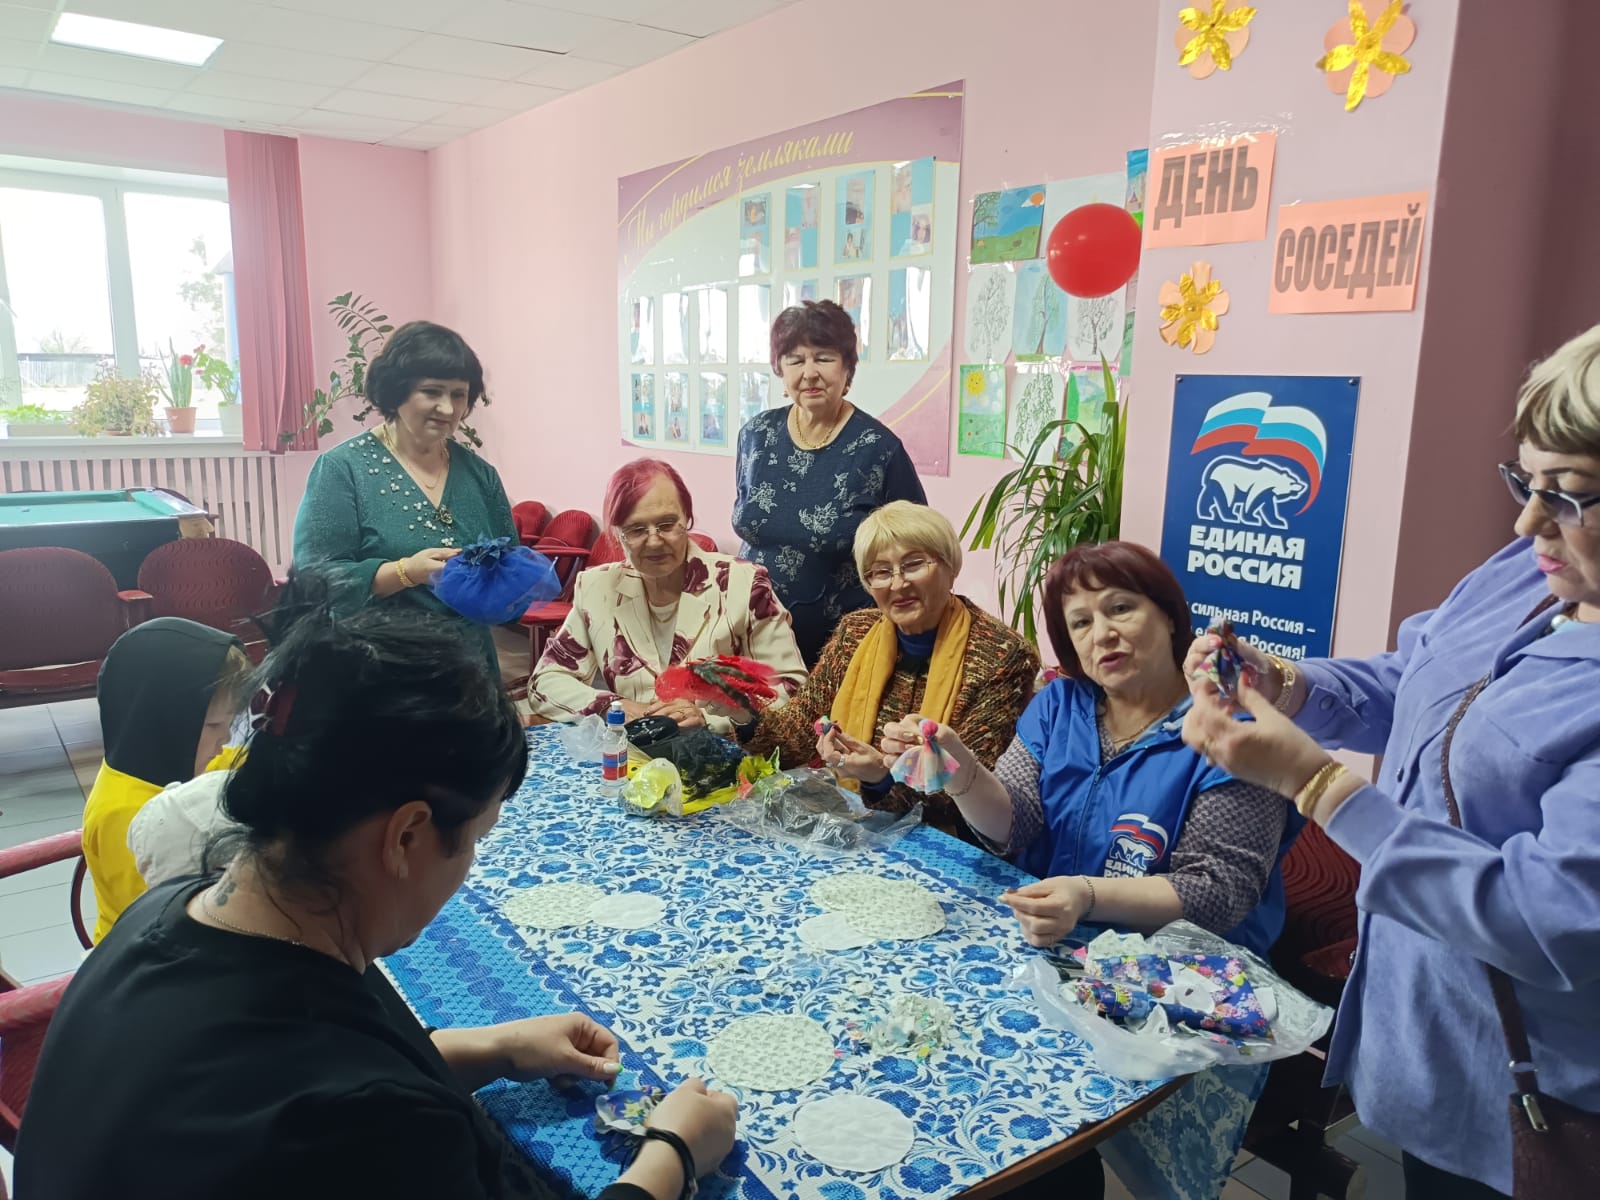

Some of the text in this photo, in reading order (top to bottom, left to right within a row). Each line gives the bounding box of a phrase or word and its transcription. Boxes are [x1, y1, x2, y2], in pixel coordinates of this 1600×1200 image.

[736, 131, 854, 193] земляками
[1153, 145, 1258, 231] ДЕНЬ
[1274, 202, 1422, 299] СОСЕДЕЙ
[1190, 525, 1305, 561] ЕДИНАЯ
[1187, 551, 1302, 589] РОССИЯ
[1191, 602, 1249, 624] сильная
[1252, 610, 1304, 635] Россия
[1250, 635, 1306, 659] Россия!
